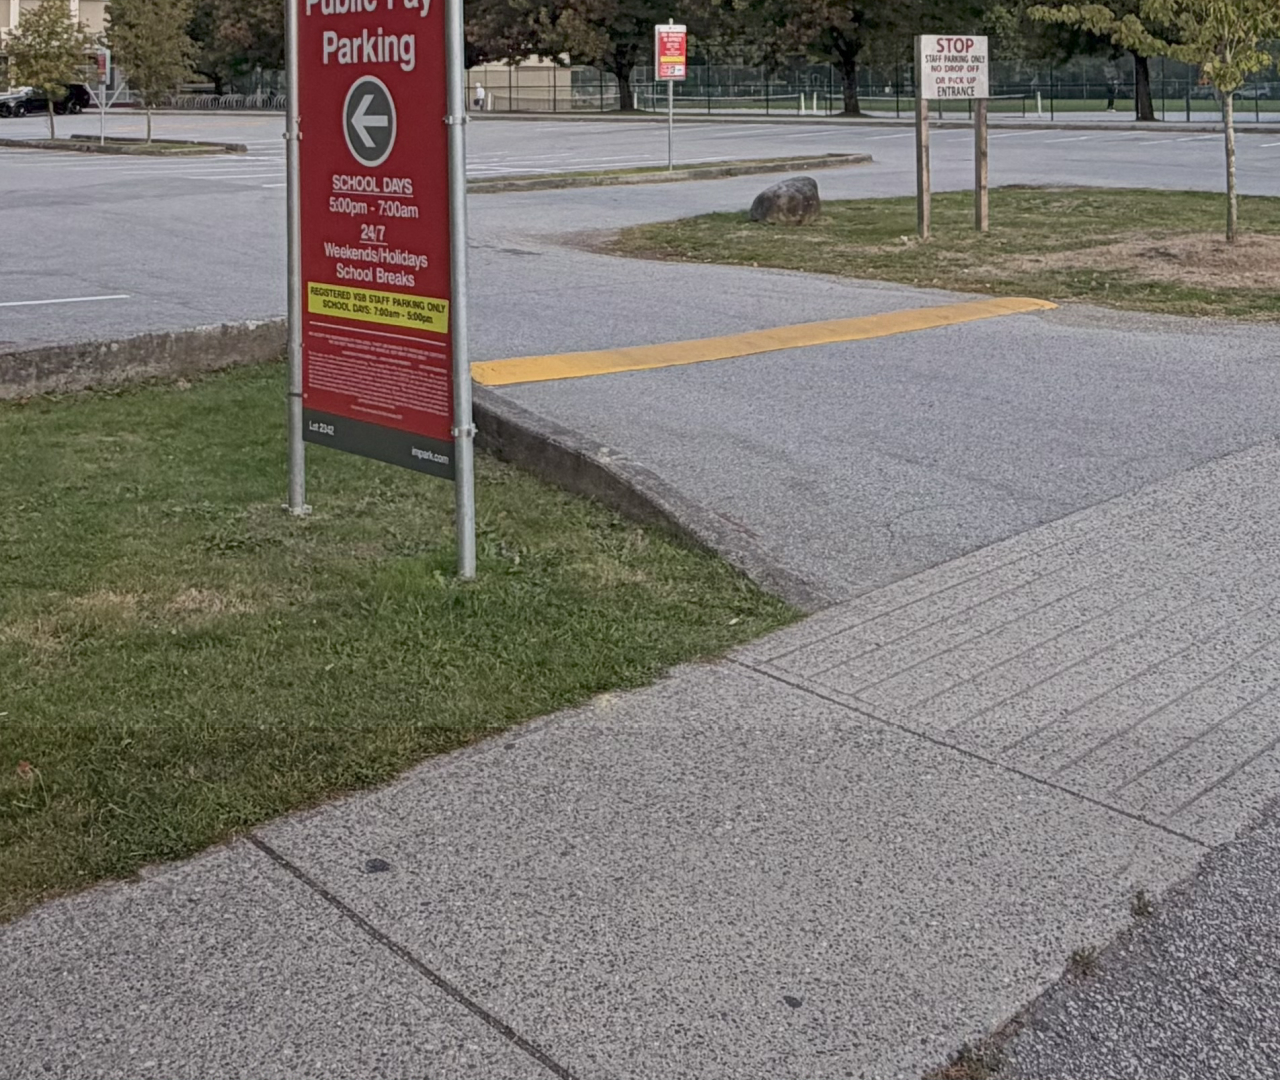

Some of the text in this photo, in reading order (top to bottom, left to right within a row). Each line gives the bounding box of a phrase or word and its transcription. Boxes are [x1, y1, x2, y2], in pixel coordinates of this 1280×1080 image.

[322, 27, 416, 72] Parking
[936, 37, 974, 54] STOP
[925, 54, 942, 63] STAFF
[943, 54, 969, 64] PARKING
[931, 65, 980, 73] NO DROP OFF
[935, 76, 946, 85] OR
[966, 76, 977, 85] UP
[937, 86, 975, 97] ENTRANCE
[332, 174, 413, 194] SCHOOL DAYS
[329, 196, 368, 217] 5:00pm
[378, 200, 419, 219] 7:00am
[360, 223, 386, 242] 24/7
[324, 241, 428, 271] Weekends/Holidays
[336, 262, 416, 287] School Breaks
[310, 286, 351, 300] REGISTERED
[368, 294, 390, 305] STAFF
[392, 297, 425, 311] PARKING
[427, 302, 446, 313] ONLY
[322, 299, 351, 312] SCHOOL
[352, 303, 372, 315] DAYS:
[373, 306, 400, 319] 7:00am
